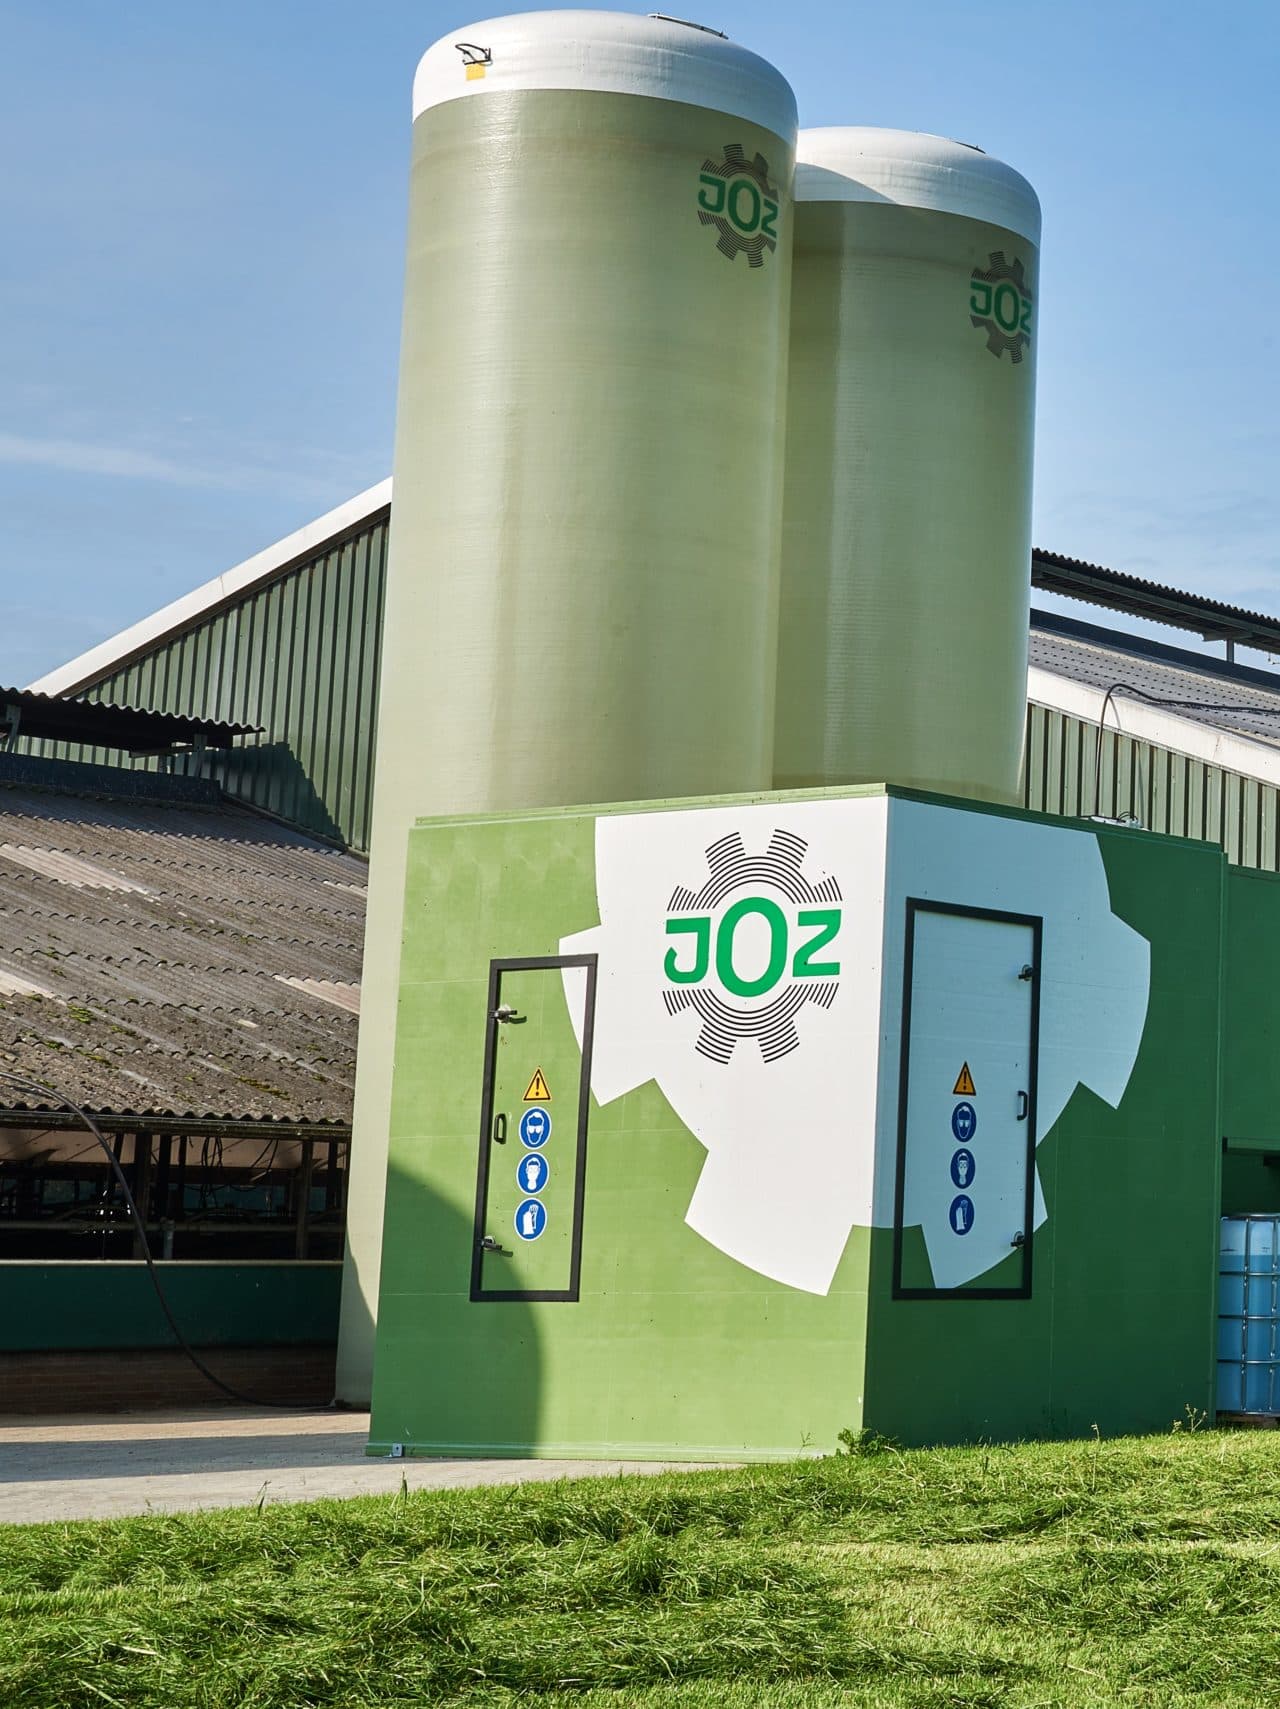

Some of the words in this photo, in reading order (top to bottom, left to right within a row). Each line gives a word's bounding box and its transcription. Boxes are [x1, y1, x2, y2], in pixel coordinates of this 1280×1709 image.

[698, 174, 778, 238] JOZ
[970, 281, 1032, 334] JOZ
[663, 896, 842, 998] JOZ
